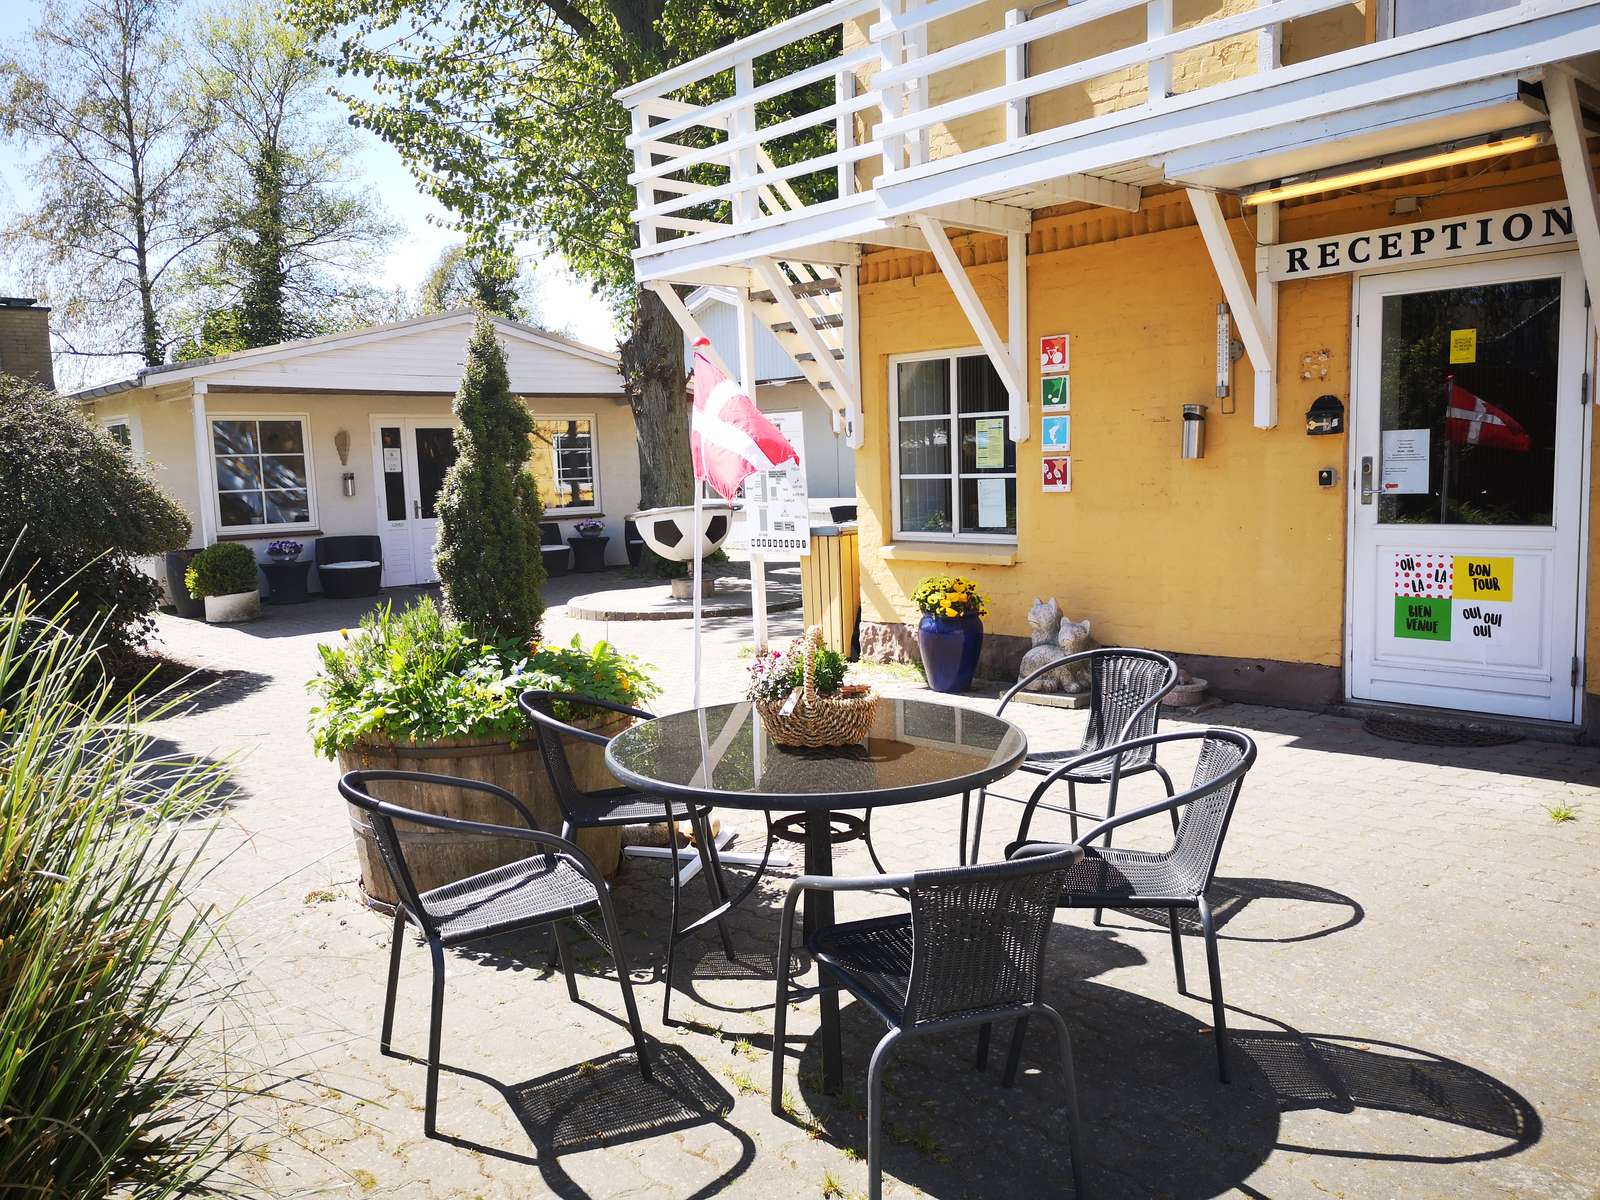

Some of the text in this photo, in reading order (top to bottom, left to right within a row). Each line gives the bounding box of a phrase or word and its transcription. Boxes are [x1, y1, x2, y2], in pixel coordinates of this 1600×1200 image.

[1286, 206, 1575, 273] RECEPTION
[1400, 557, 1415, 571] OH
[1468, 563, 1491, 577] BON
[1434, 569, 1447, 583] LA
[1411, 579, 1425, 593] LA
[1472, 577, 1500, 592] TOUR
[1408, 605, 1432, 618] BIEN
[1462, 606, 1502, 627] OUI OUI
[1406, 618, 1439, 633] VENUE
[1473, 625, 1492, 638] OUI
